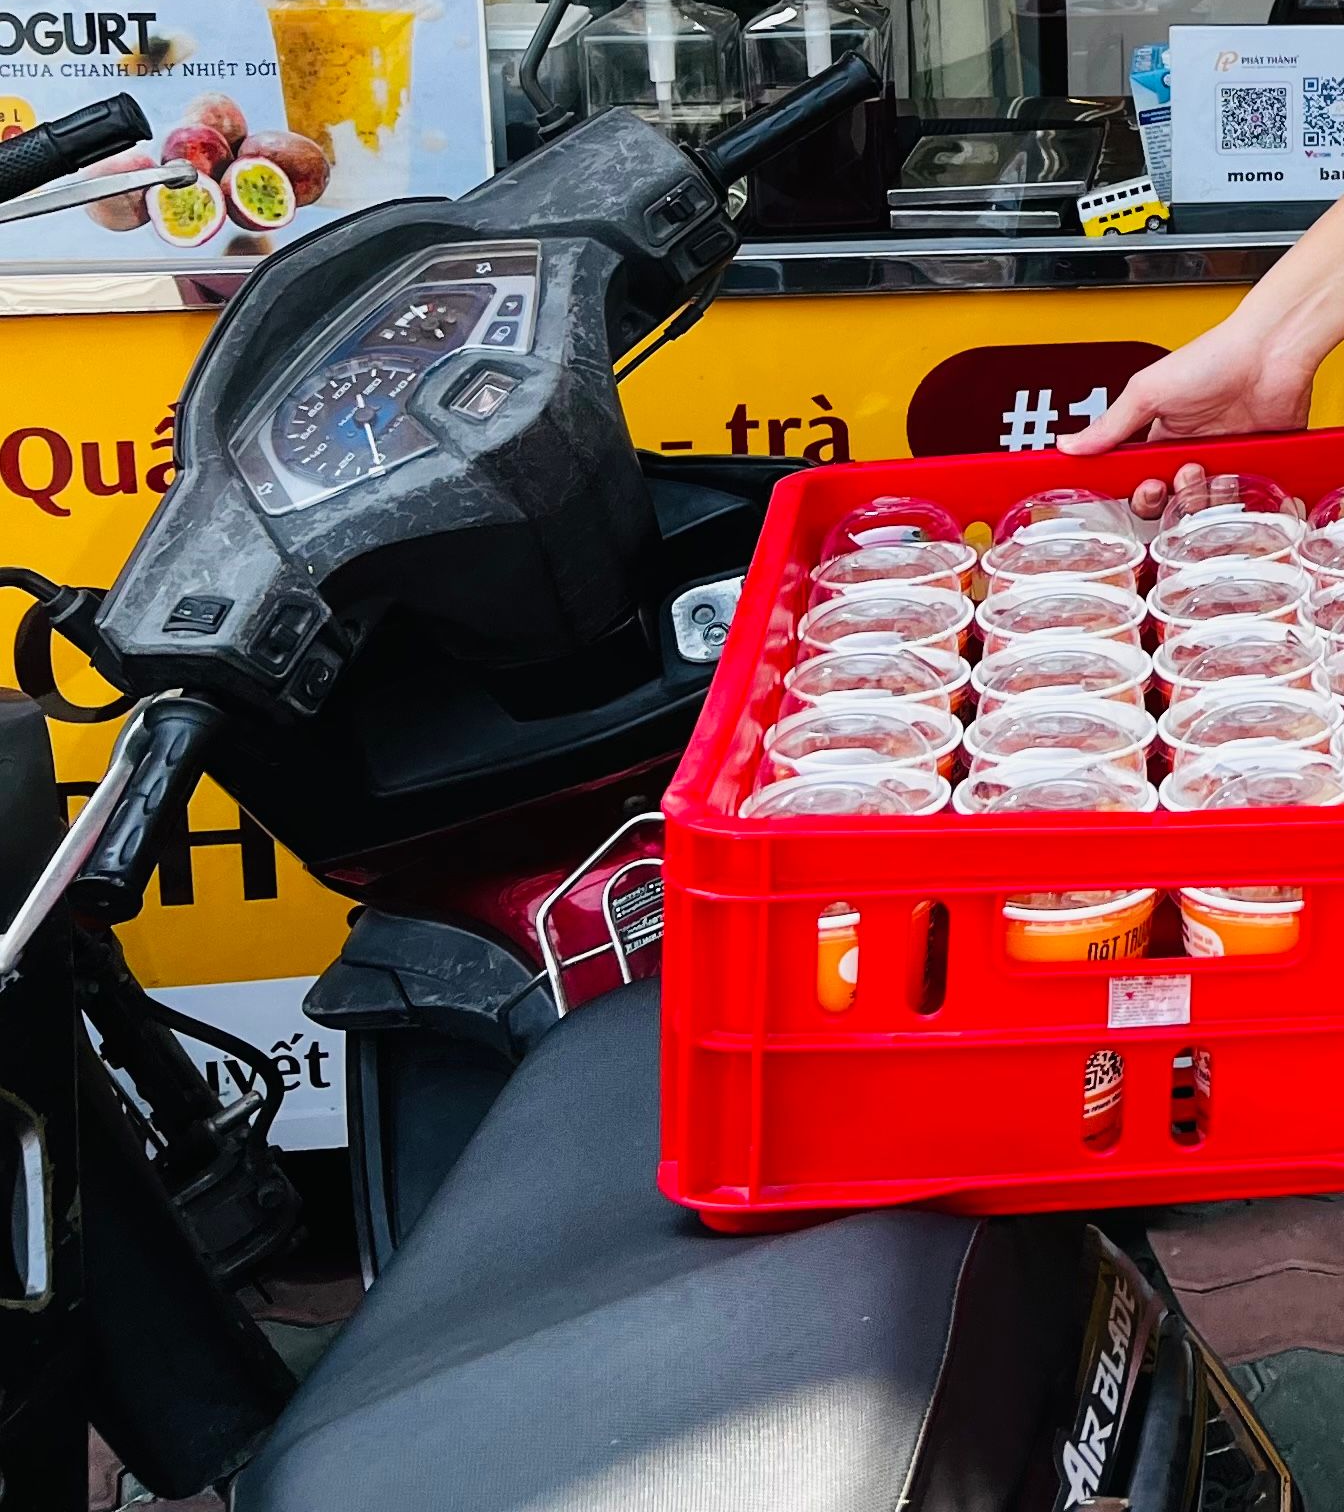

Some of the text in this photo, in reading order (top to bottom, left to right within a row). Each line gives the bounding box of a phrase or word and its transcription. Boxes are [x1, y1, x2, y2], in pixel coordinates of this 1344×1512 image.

[60, 63, 130, 78] CHANH
[182, 61, 239, 80] NHIỆT
[245, 57, 278, 78] ĐỚI
[1226, 169, 1285, 183] momo
[725, 393, 857, 465] trà
[1063, 1275, 1139, 1511] AIR BLADE
